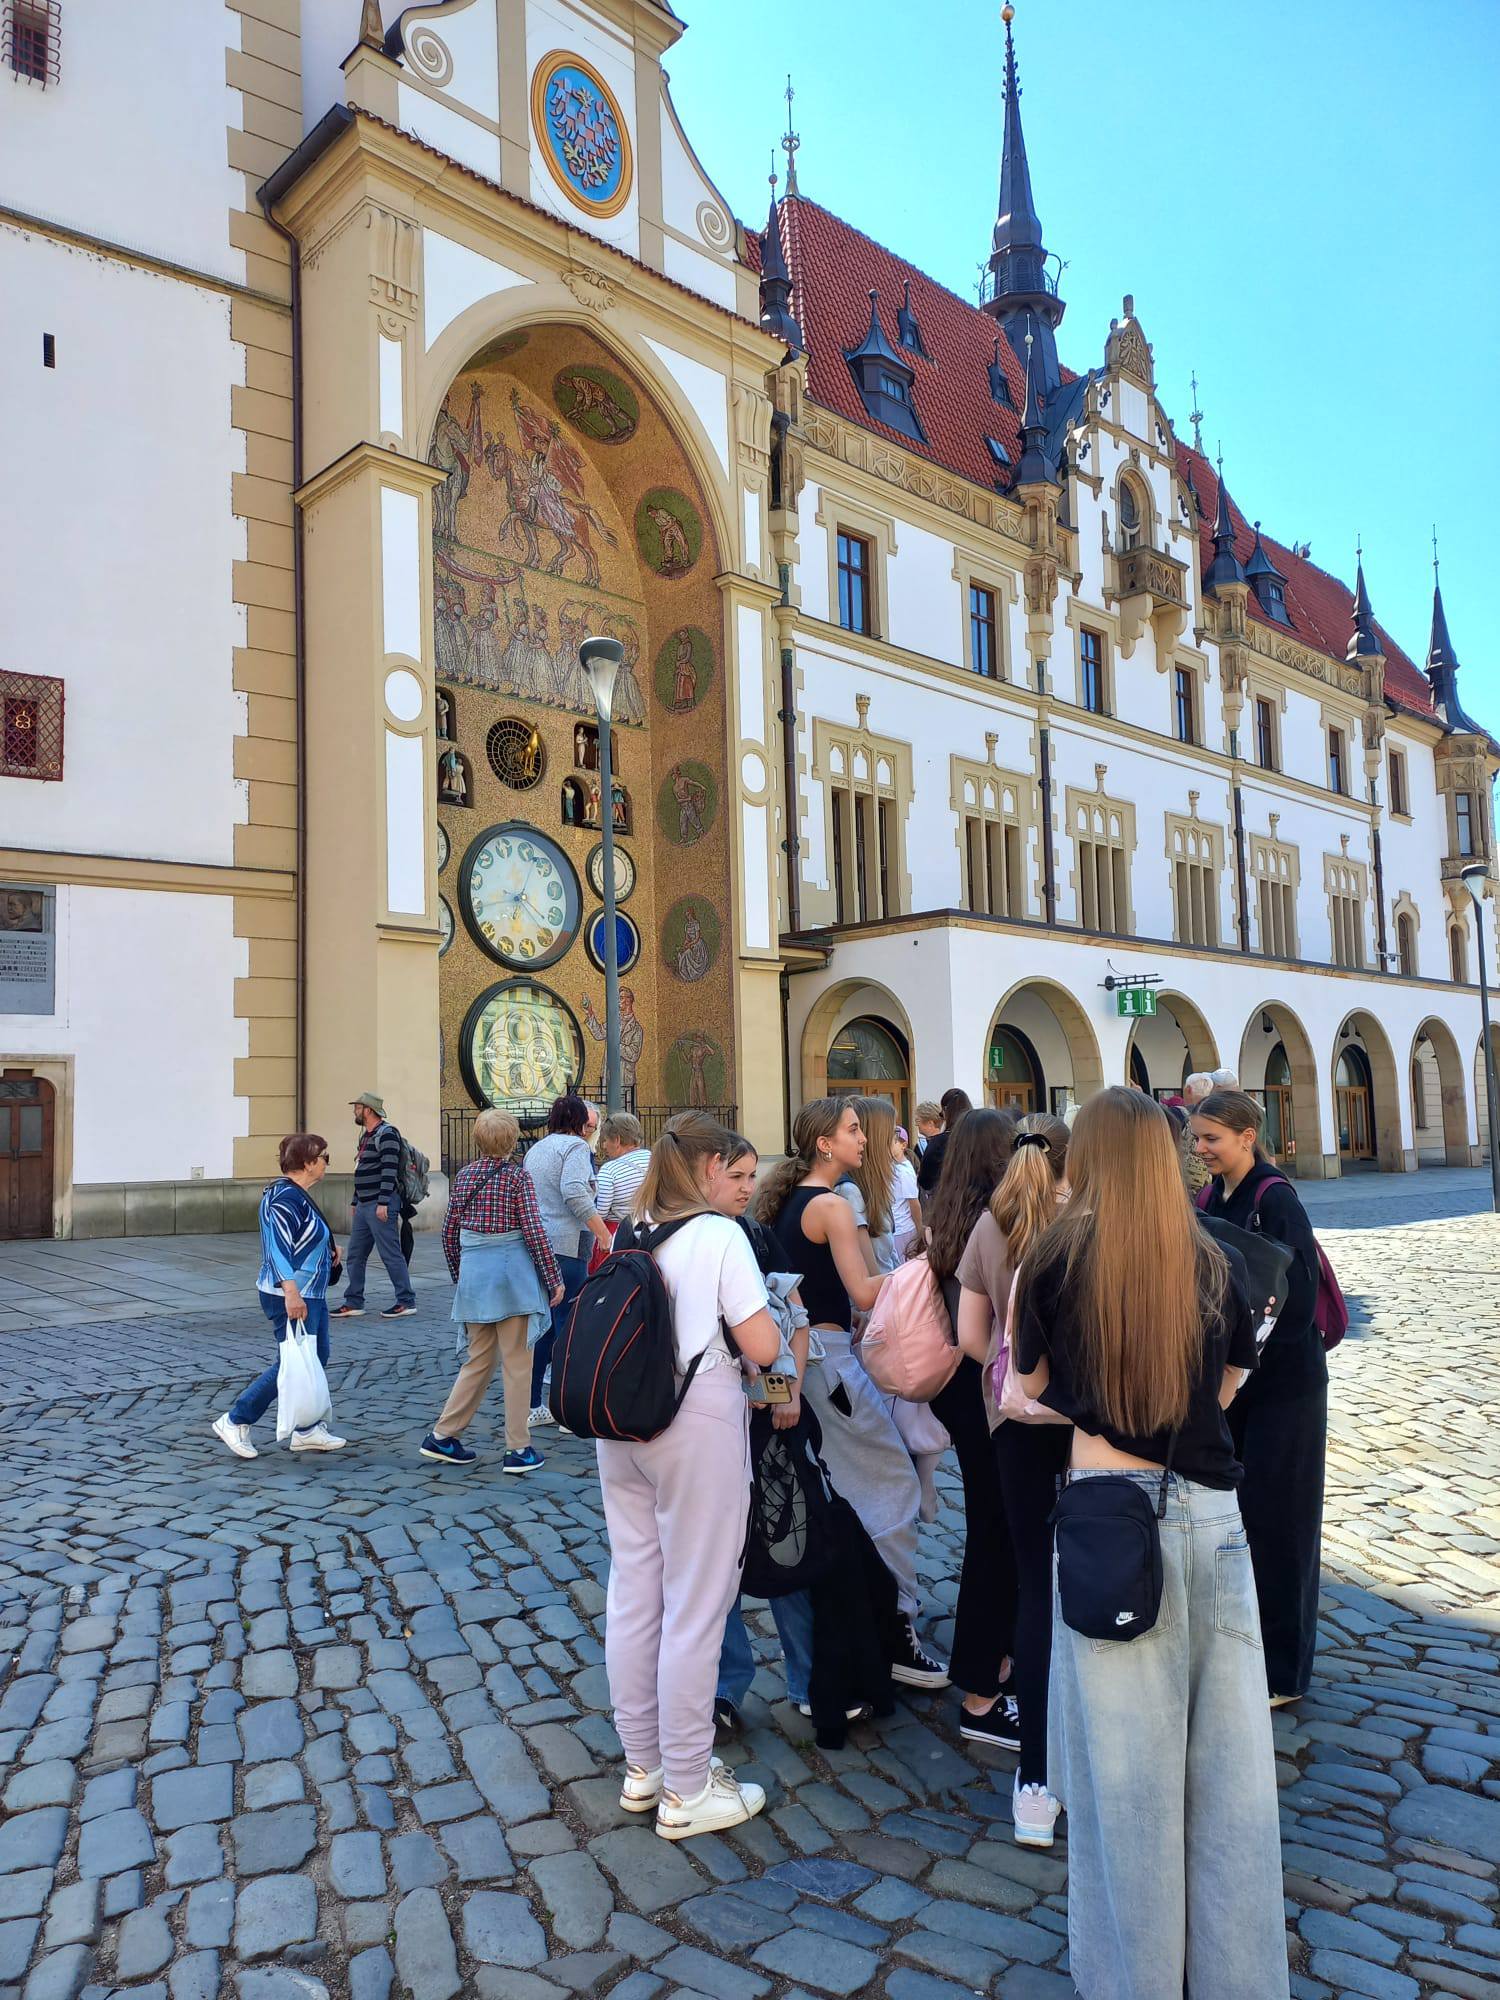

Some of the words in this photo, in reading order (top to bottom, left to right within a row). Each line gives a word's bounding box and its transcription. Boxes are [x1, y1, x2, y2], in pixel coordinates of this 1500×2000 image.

[1123, 992, 1135, 1013] i
[1144, 991, 1154, 1013] i
[993, 1048, 1002, 1067] i
